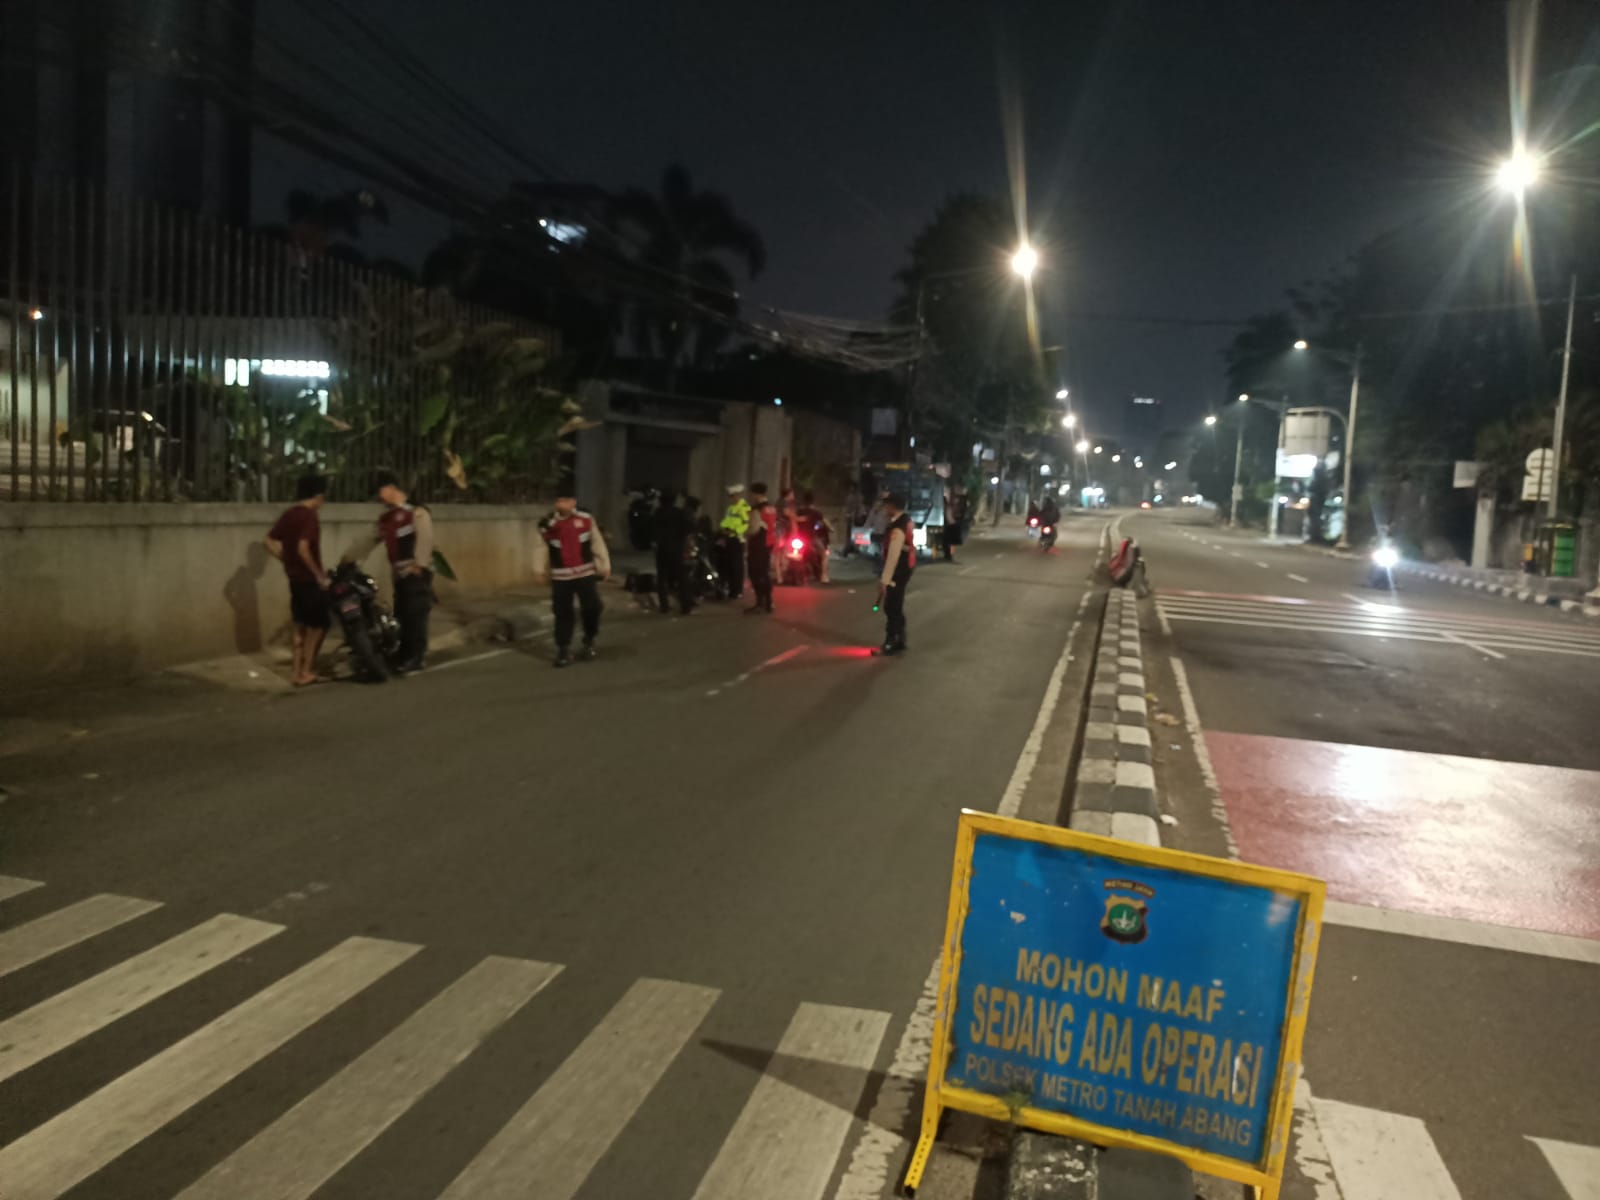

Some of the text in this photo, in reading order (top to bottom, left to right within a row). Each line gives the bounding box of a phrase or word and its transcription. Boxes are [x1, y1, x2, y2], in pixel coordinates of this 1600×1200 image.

[1016, 947, 1225, 1023] MOHON MAAF
[970, 984, 1263, 1108] SEDANG ADA OPERASI
[1041, 1072, 1107, 1111] METRO
[1114, 1088, 1177, 1127] TANAH
[1181, 1106, 1252, 1146] ABANG
